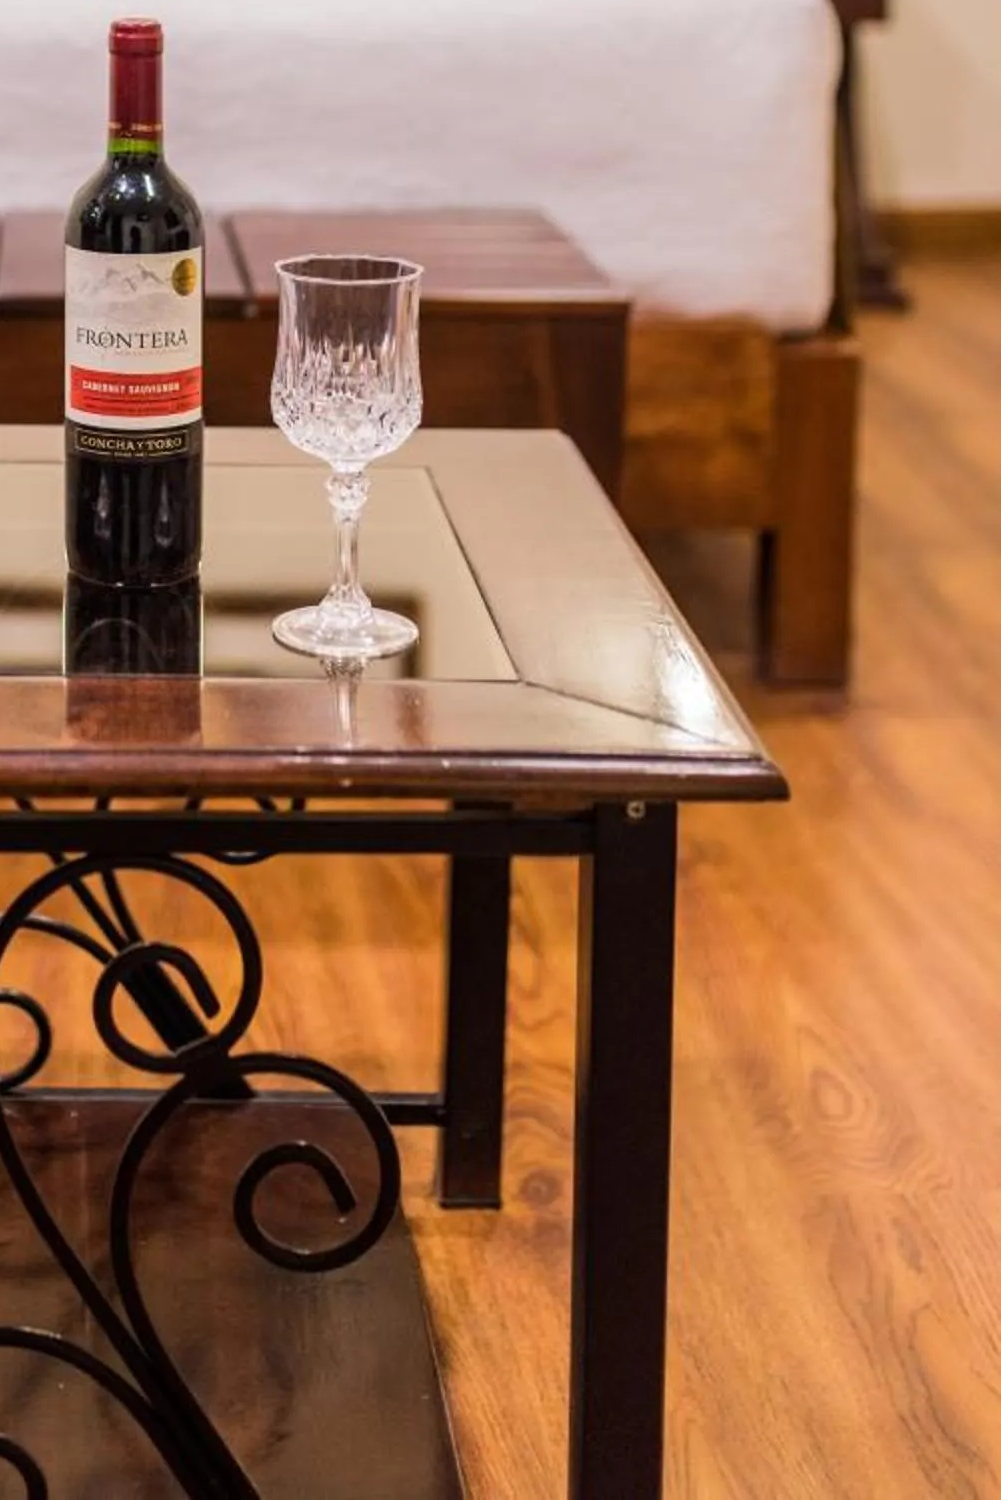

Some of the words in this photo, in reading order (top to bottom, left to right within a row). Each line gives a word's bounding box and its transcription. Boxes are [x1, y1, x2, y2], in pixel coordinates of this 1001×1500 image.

[76, 326, 188, 348] FRONTERA
[82, 380, 125, 393] CABERNET
[128, 382, 180, 395] SAUVIGNON
[80, 435, 136, 451] CONCHA
[146, 437, 183, 451] TORO
